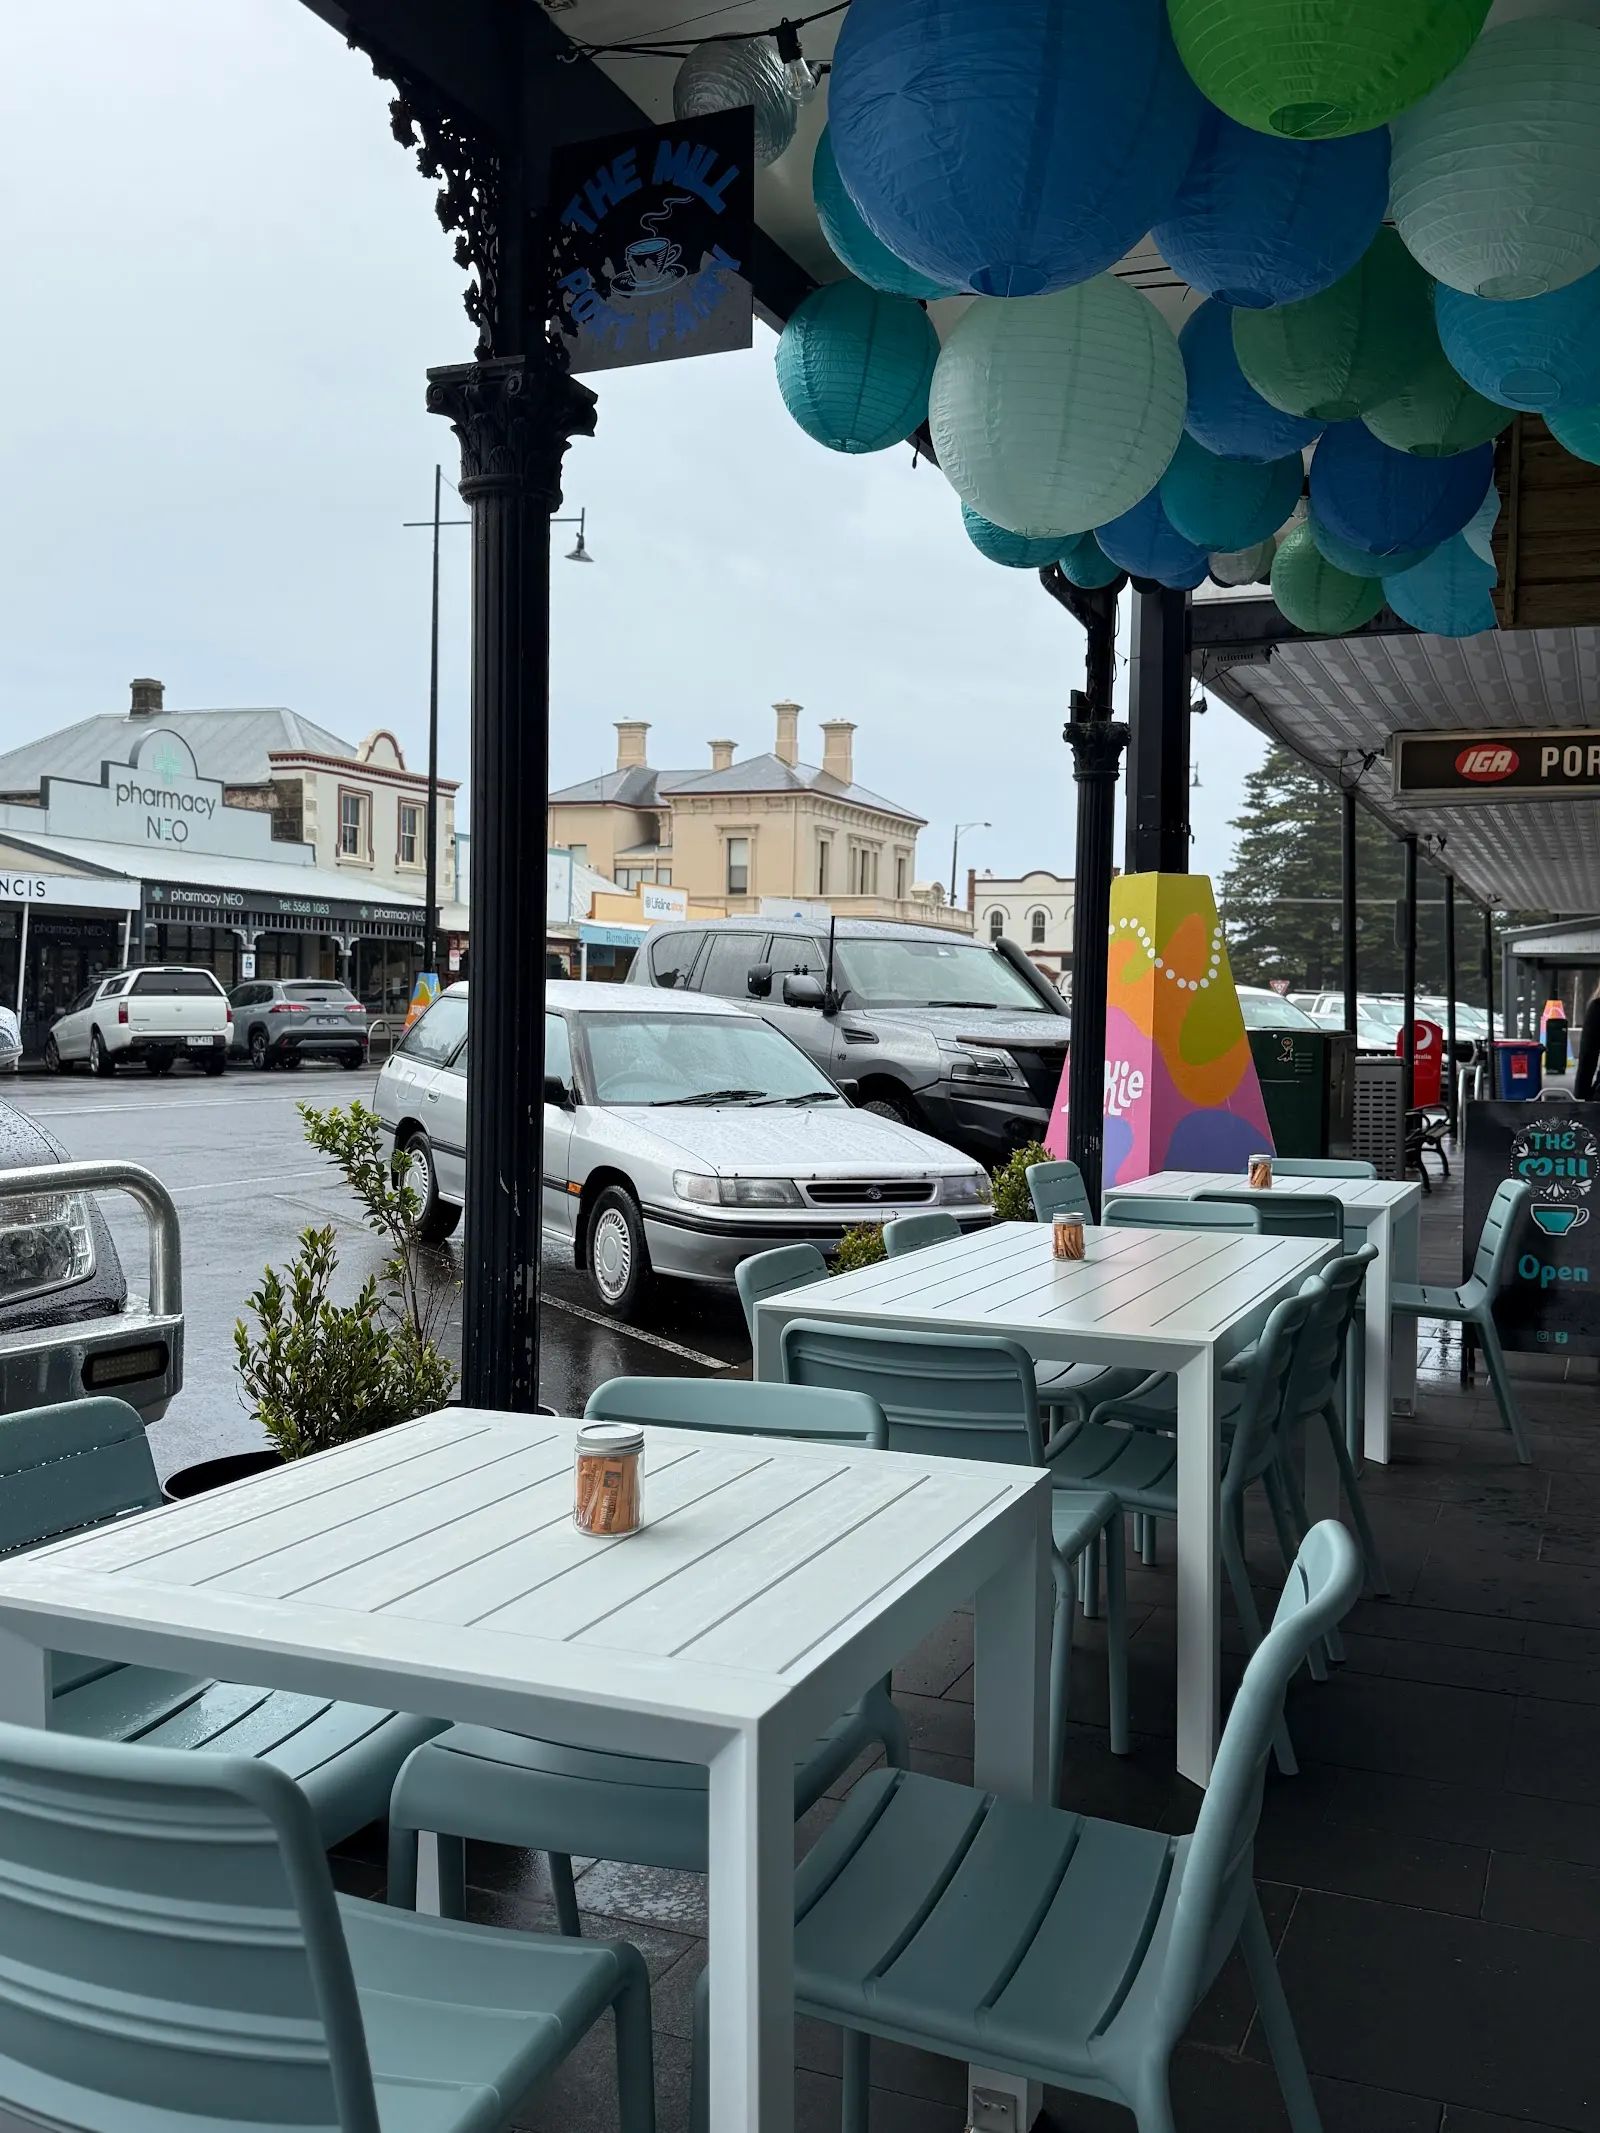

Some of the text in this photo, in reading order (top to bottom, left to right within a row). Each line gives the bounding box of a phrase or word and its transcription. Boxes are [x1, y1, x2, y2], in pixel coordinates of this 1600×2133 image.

[560, 140, 741, 234] THE MILL
[1462, 745, 1600, 777] IGA POR
[116, 780, 216, 820] pharmacy
[147, 816, 188, 842] NEO
[0, 878, 46, 897] NCIS
[171, 888, 244, 906] pharmacy NEO
[293, 901, 311, 913] 5568
[313, 903, 330, 914] 1083
[373, 908, 411, 922] pharmacy
[34, 923, 104, 936] pharmacy NEO
[1530, 1131, 1576, 1150] THE
[1518, 1157, 1589, 1178] Mill
[1518, 1254, 1589, 1289] Open
